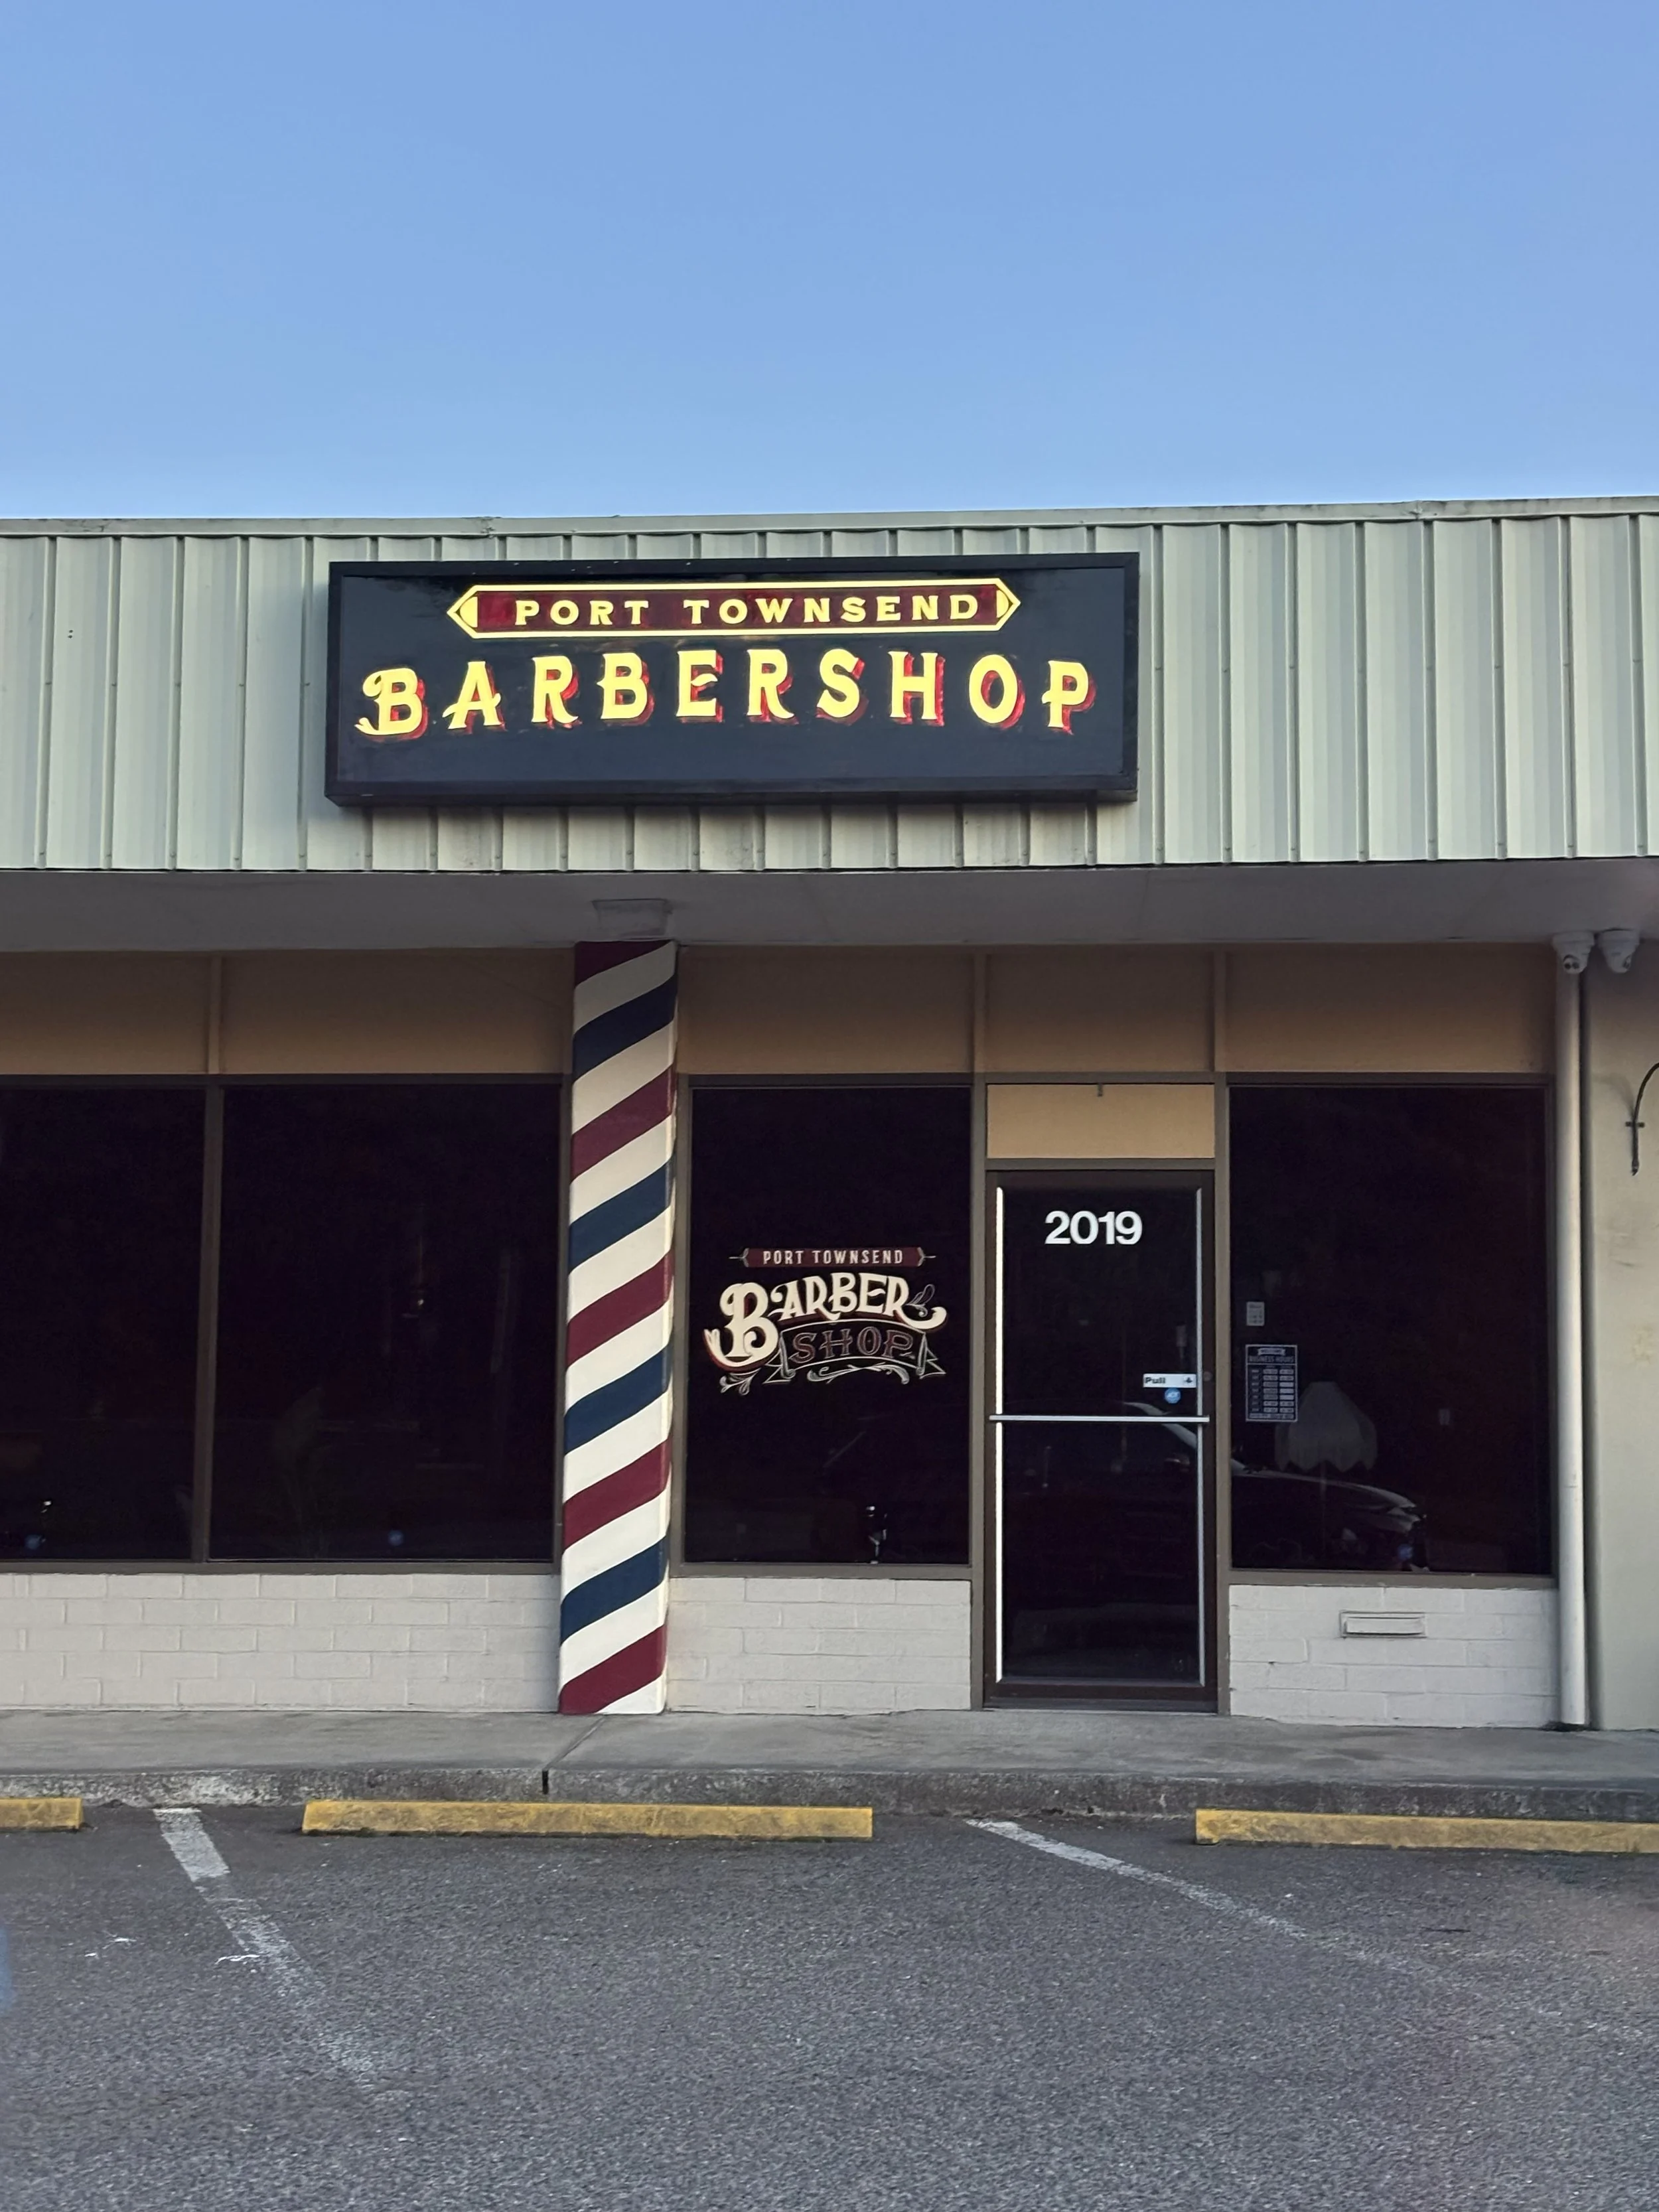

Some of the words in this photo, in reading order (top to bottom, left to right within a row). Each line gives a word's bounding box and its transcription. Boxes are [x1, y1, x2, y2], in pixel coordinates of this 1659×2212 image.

[514, 599, 649, 625] PORT
[683, 595, 979, 625] TOWNSEND
[354, 648, 1094, 739] BARBERSHOP
[1045, 1211, 1143, 1245] 2019
[762, 1250, 804, 1265] PORT
[812, 1249, 904, 1264] TOWNSEND
[703, 1272, 948, 1368] BARBER
[789, 1327, 914, 1363] SHOP
